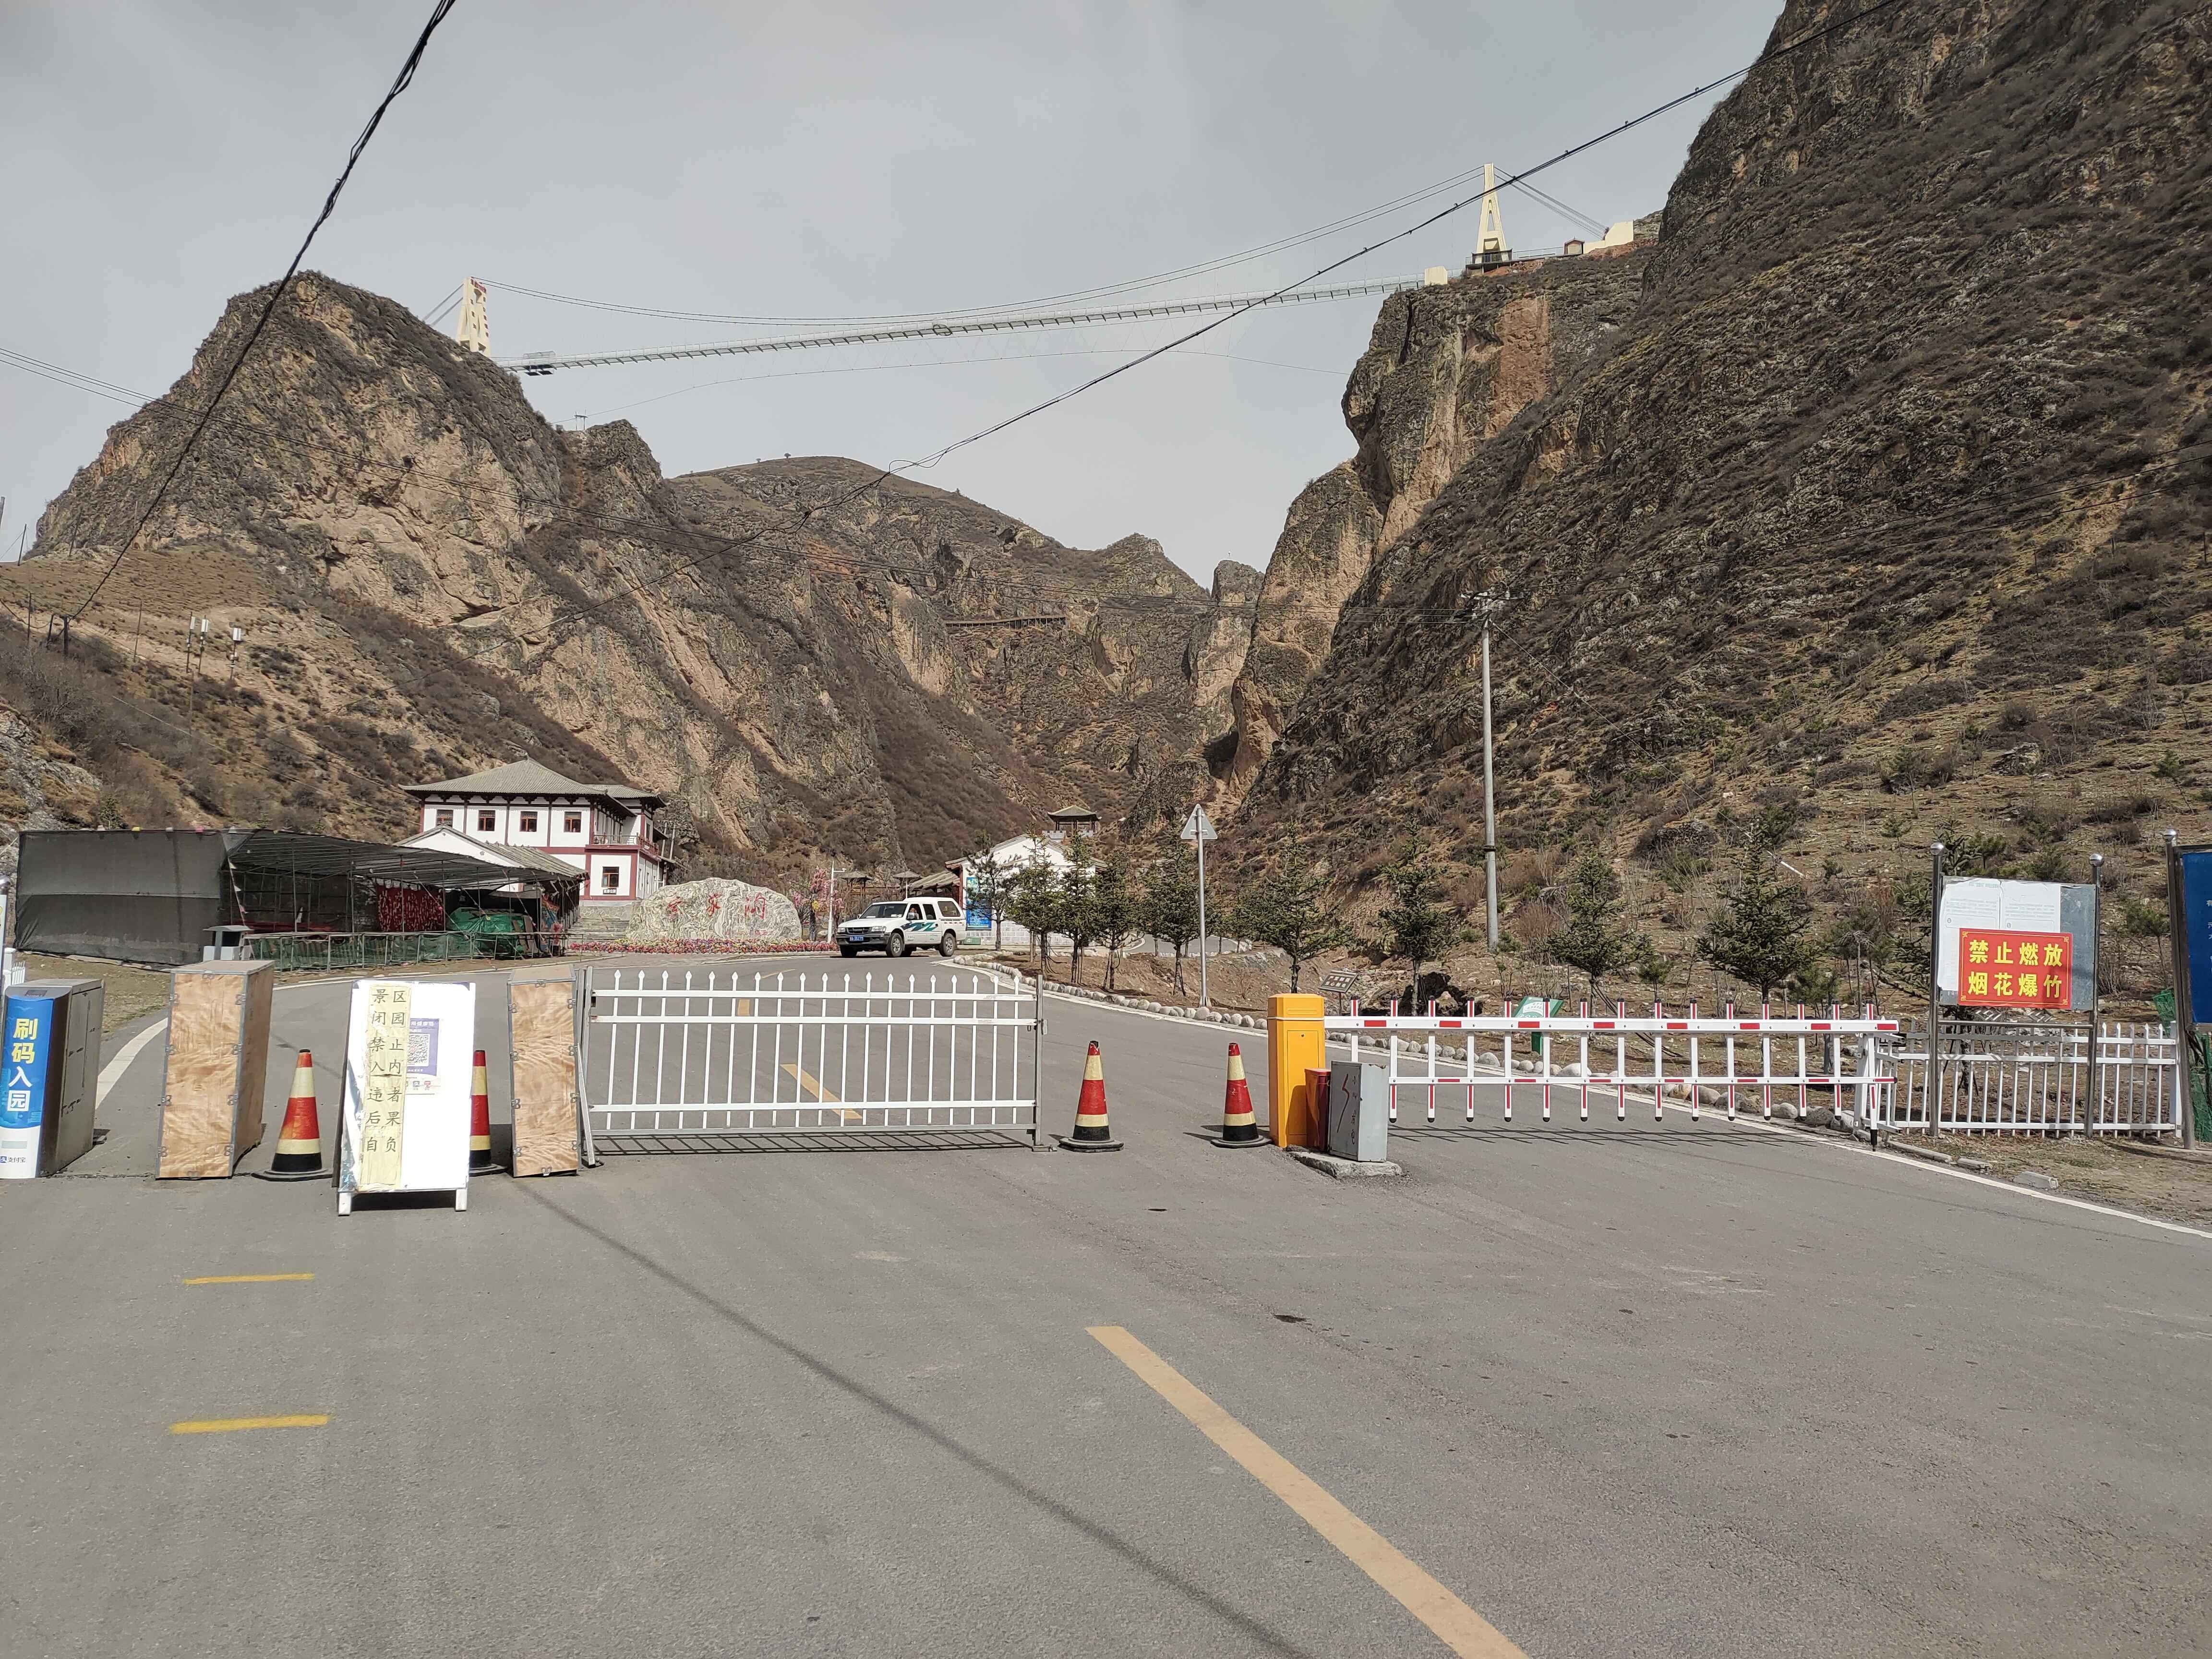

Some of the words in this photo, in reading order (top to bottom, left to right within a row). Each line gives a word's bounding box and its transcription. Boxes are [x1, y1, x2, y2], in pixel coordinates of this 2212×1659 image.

[1969, 939, 2063, 967] 禁止燃放
[1968, 971, 2062, 998] 烟花爆竹
[372, 989, 406, 1003] 景区
[372, 1011, 405, 1025] 闭园
[370, 1037, 404, 1053] 禁止
[7, 1018, 38, 1112] 刷码入园
[370, 1059, 401, 1074] 入内
[367, 1087, 402, 1103] 违者
[365, 1111, 400, 1126] 后果
[366, 1136, 397, 1153] 自负
